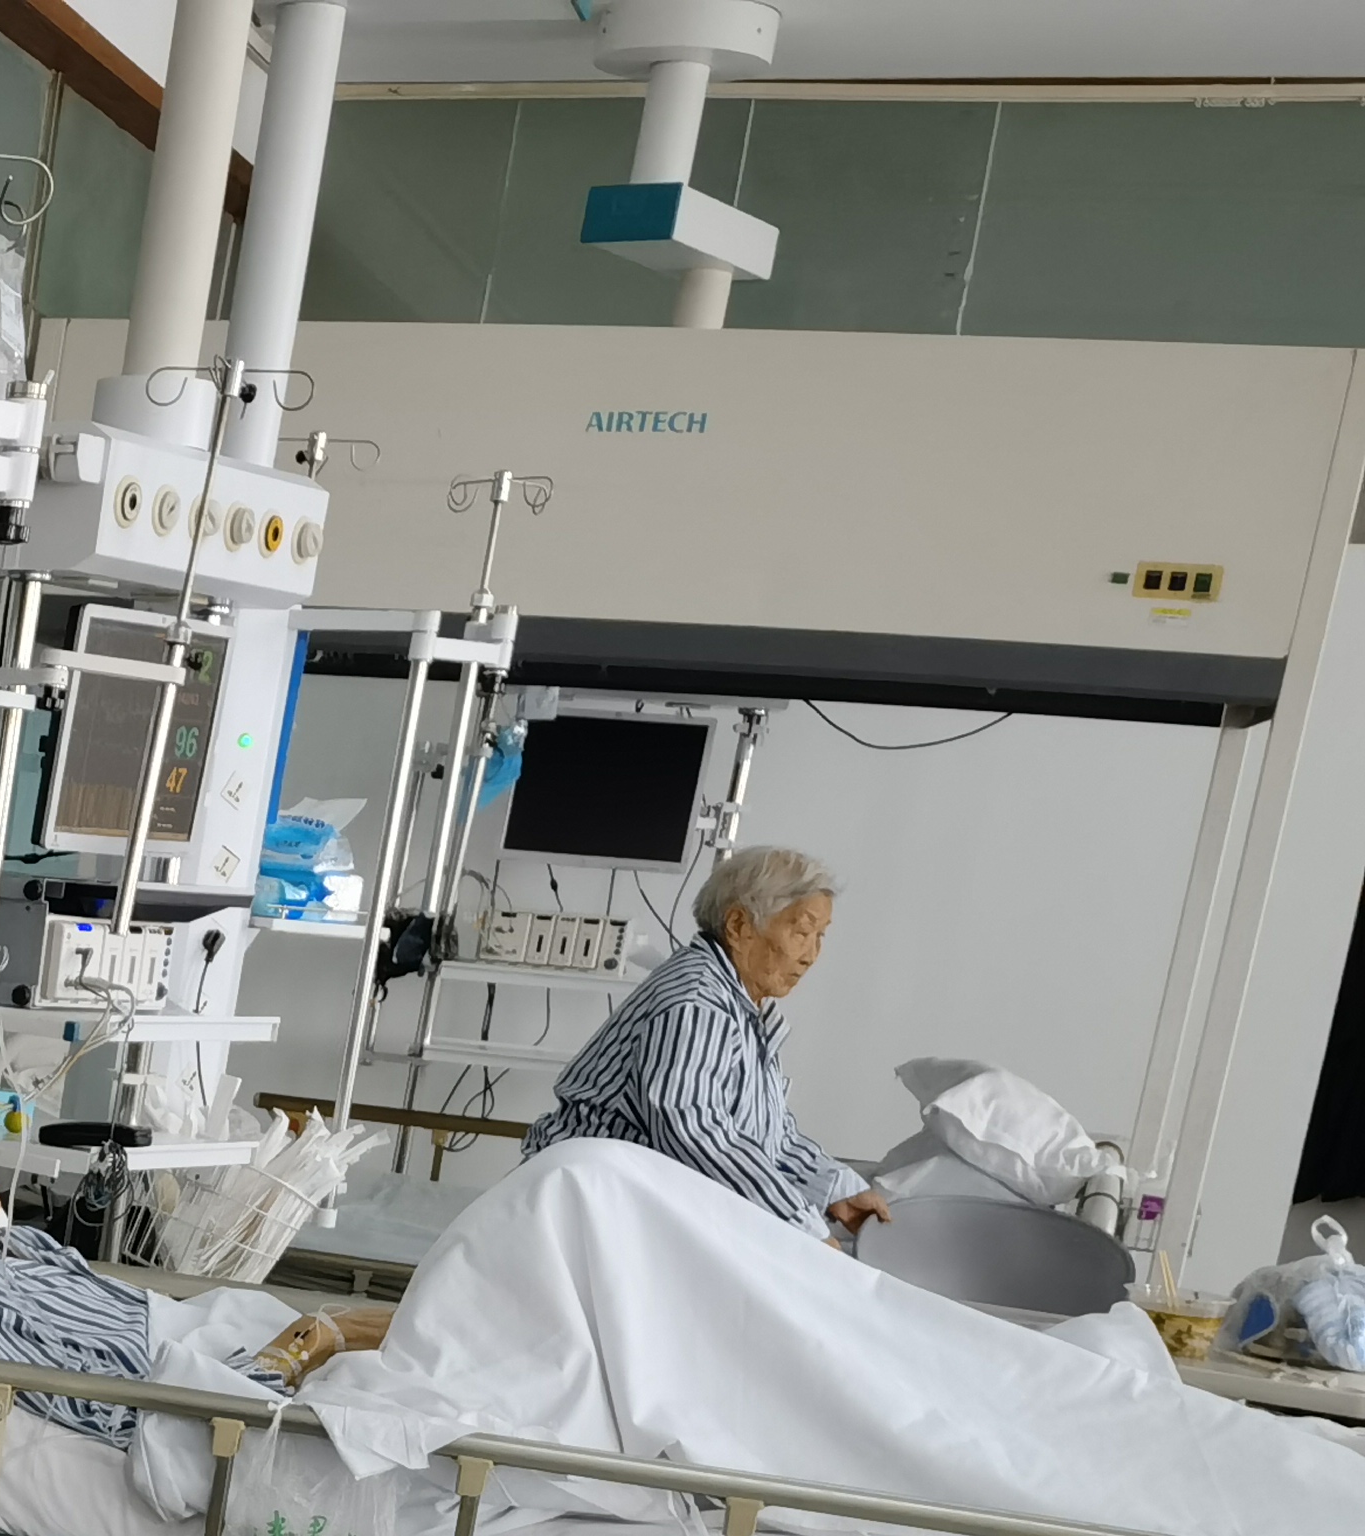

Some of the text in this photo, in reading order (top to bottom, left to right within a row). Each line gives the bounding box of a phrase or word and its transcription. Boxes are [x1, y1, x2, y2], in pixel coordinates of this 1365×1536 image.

[585, 411, 707, 433] AIRTECH
[175, 726, 199, 758] 96
[166, 767, 188, 793] 47
